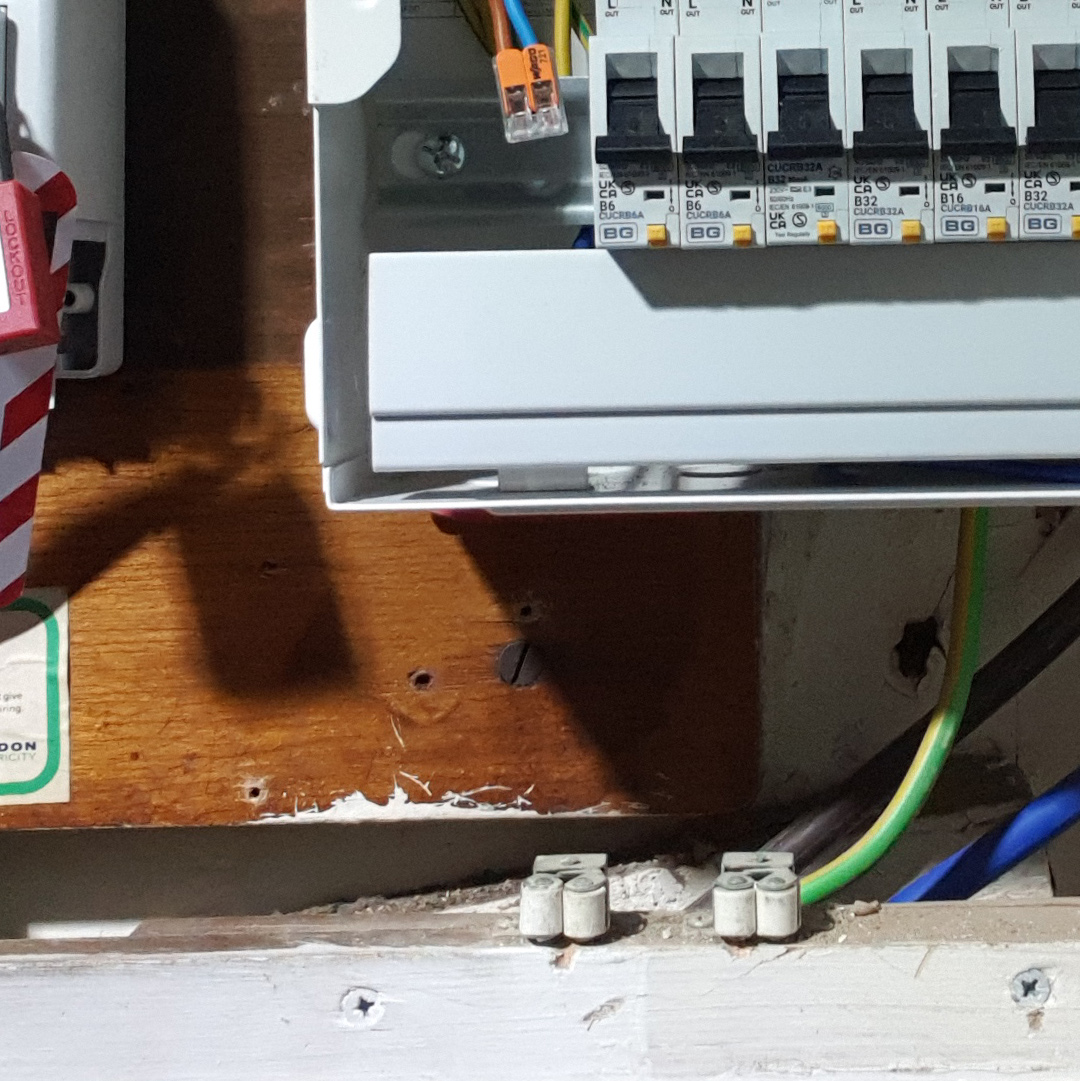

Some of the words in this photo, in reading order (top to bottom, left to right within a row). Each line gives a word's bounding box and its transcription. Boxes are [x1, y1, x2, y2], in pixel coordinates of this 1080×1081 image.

[767, 162, 823, 172] CUCRB32A
[768, 175, 786, 184] B32
[940, 173, 958, 181] UK
[1024, 171, 1041, 179] UK
[854, 176, 871, 184] UK
[1024, 180, 1042, 189] CA
[599, 181, 616, 189] UK
[685, 181, 703, 189] UK
[854, 185, 872, 194] CA
[941, 182, 958, 191] CA
[599, 190, 617, 198] CA
[686, 189, 703, 198] CA
[1025, 191, 1048, 201] B32
[855, 196, 877, 207] B32
[941, 194, 964, 204] B16
[600, 201, 615, 211] B6
[687, 200, 702, 211] B6
[941, 204, 991, 213] CUCRB16A
[1024, 202, 1074, 211] CUCRB32A
[599, 211, 644, 220] CUCRB6A
[686, 211, 731, 219] CUCRB6A
[769, 212, 785, 220] UK
[854, 208, 904, 216] CUCRB32A
[769, 221, 787, 229] CA
[945, 220, 975, 232] BG
[1028, 218, 1057, 230] BG
[604, 227, 633, 239] BG
[691, 227, 720, 239] BG
[859, 223, 888, 235] BG
[4, 210, 27, 305] LOCKOUT
[3, 694, 23, 702] give
[0, 741, 36, 752] DON
